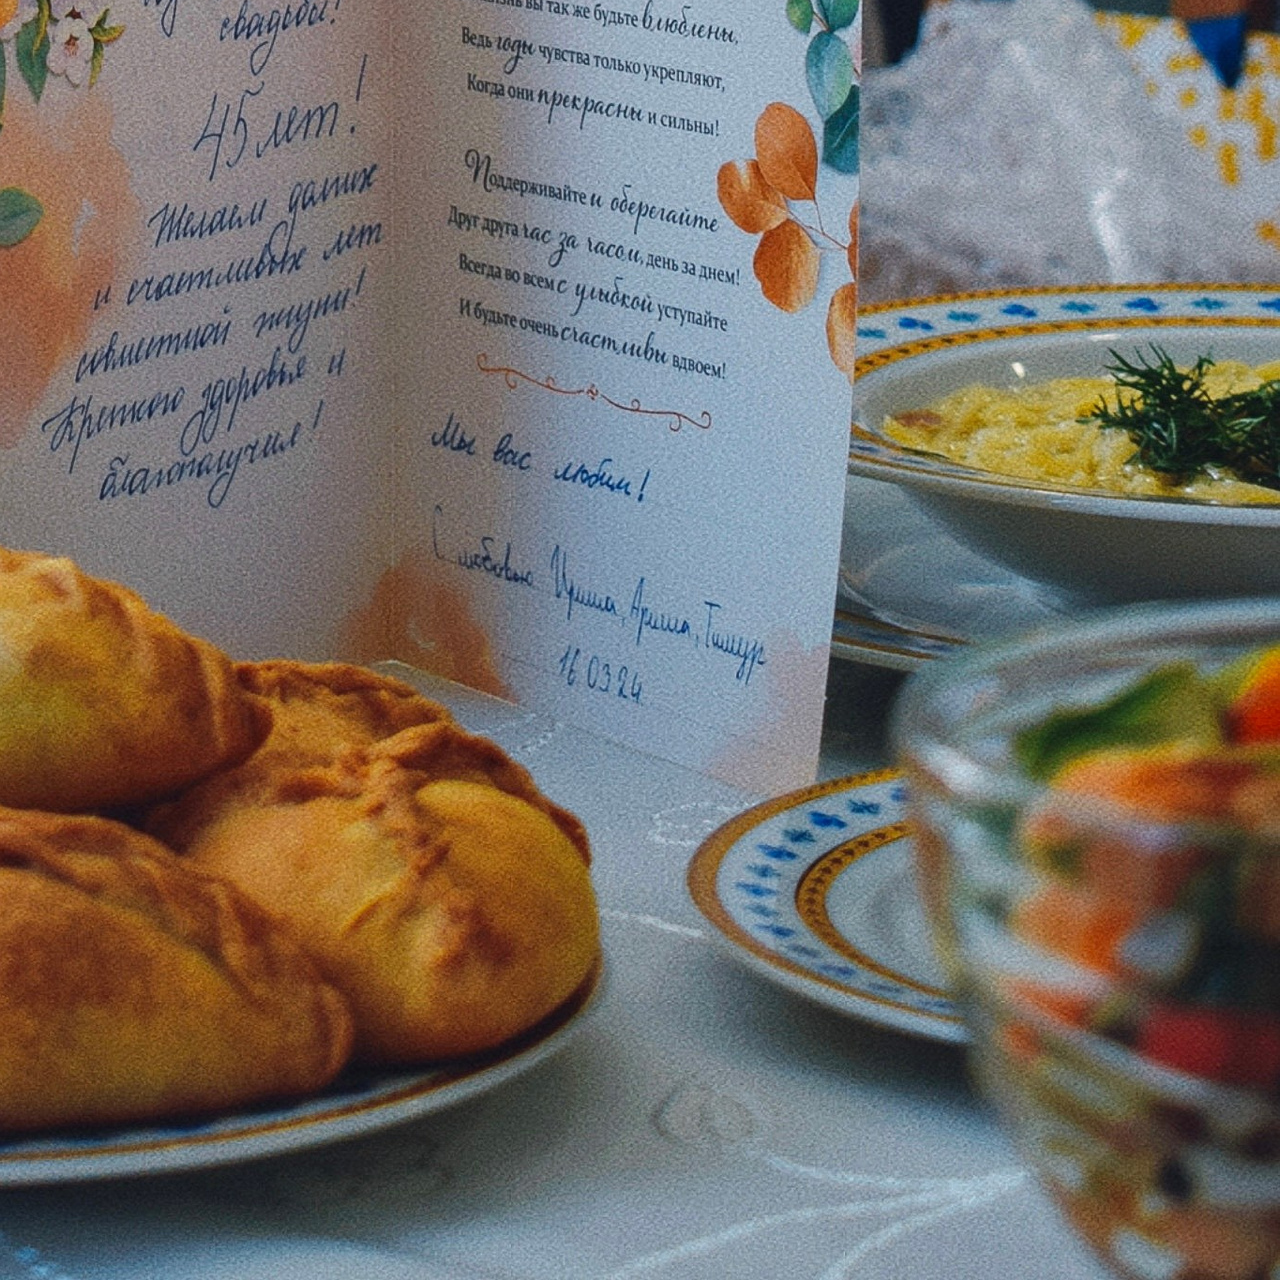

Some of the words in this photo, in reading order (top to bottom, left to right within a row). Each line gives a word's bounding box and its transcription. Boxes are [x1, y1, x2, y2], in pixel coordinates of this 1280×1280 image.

[461, 26, 493, 50] Ведь
[495, 36, 536, 75] годы
[538, 44, 591, 67] чувства
[593, 53, 642, 76] только
[643, 61, 726, 92] укрепляют,
[546, 0, 570, 17] так
[572, 2, 591, 20] же
[593, 3, 639, 28] будьте
[640, 0, 739, 45] влюблены,
[192, 81, 265, 181] 45
[256, 53, 368, 159] лет!
[467, 72, 505, 98] Когда
[507, 84, 534, 102] они
[536, 88, 643, 130] прекрасны
[647, 110, 657, 125] и
[659, 112, 720, 137] сильны!
[146, 199, 268, 248] Желаем
[465, 148, 587, 206] Поддерживайте
[590, 192, 603, 208] и
[610, 184, 719, 235] оберегайте
[93, 285, 112, 312] и
[126, 238, 309, 307] счастливых
[322, 222, 384, 262] лет
[448, 205, 480, 230] Друг
[481, 213, 519, 239] друга
[523, 224, 552, 245] час
[548, 230, 579, 268] за
[587, 237, 644, 266] часом,
[646, 252, 679, 274] день
[681, 261, 696, 276] за
[699, 266, 741, 287] днем!
[75, 304, 233, 384] совместной
[253, 266, 368, 354] жизни!
[459, 253, 502, 279] Всегда
[504, 268, 520, 283] во
[523, 272, 554, 292] всем
[570, 277, 654, 317] улыбкой
[657, 302, 729, 332] уступайте
[459, 298, 471, 317] И
[473, 301, 518, 325] будьте
[519, 317, 559, 338] очень
[560, 326, 669, 365] счастливы
[671, 353, 726, 379] вдвоем!
[41, 386, 186, 475] Крепкого
[179, 346, 308, 457] здоровья
[326, 348, 347, 377] и
[99, 399, 325, 509] благополучия!
[431, 412, 476, 456] Мы
[493, 433, 532, 471] вас
[554, 457, 650, 502] любим!
[457, 536, 534, 587] любовью
[704, 600, 766, 686] Тимур
